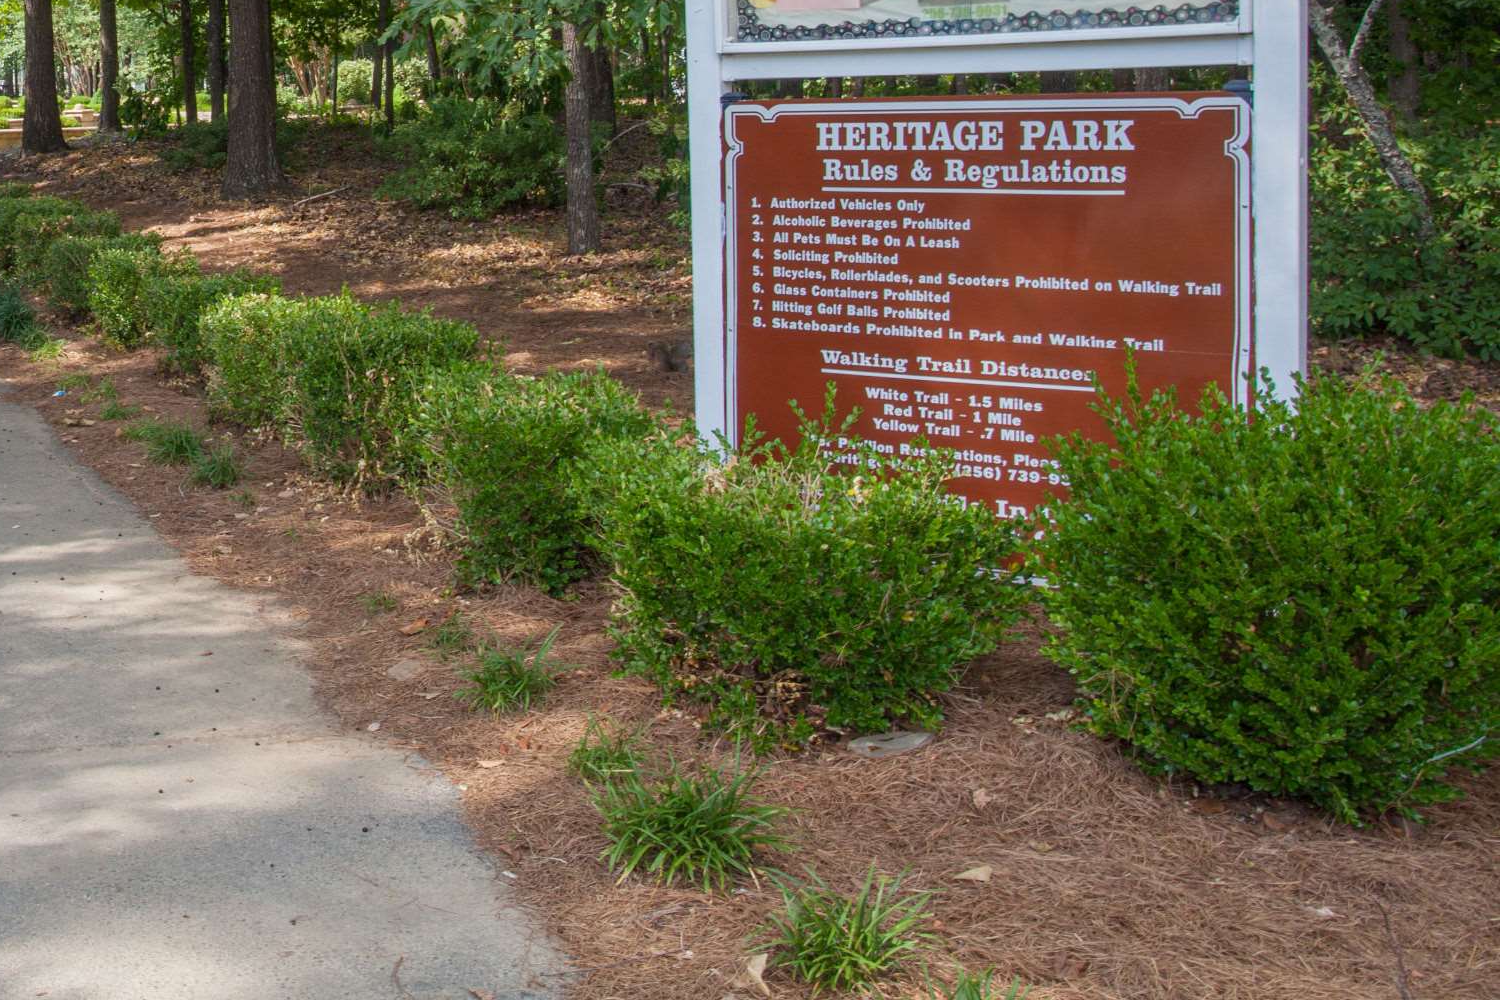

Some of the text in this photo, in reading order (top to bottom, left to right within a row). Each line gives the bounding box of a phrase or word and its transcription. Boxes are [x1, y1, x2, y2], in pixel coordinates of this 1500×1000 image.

[816, 120, 1136, 151] HERITAGE PARK
[823, 159, 1127, 188] Rules & Regulations
[751, 197, 925, 214] 1. Authorized Vehicles Only
[752, 214, 971, 231] 2. Alcoholic Beverages Prohibited
[752, 231, 960, 249] 3. All Pets Must Be On A Leash
[752, 248, 898, 265] 4. Soliciting Prohibited
[752, 265, 1222, 297] 5. Bicycles, Rollerblades, and Scooters Prohibited on Walking Trail
[752, 282, 950, 303] 6. Glass Containers Prohibited
[752, 299, 950, 321] 7. Hitting Golf Balls Prohibited
[752, 316, 1164, 351] 8. Skateboards Prohibited in Park and Walking Trail
[820, 350, 908, 373] Walking
[916, 356, 972, 375] Trail
[865, 387, 908, 402] White
[914, 390, 949, 405] Trail
[968, 395, 993, 408] 1.5
[999, 397, 1043, 412] Miles
[884, 404, 913, 418] Red
[918, 407, 953, 421] Trail
[973, 411, 981, 423] 1
[988, 412, 1022, 426] Mile
[873, 418, 919, 434] Yellow
[925, 422, 960, 437] Trail
[980, 427, 994, 440] .7
[1001, 429, 1035, 443] Mile
[1013, 454, 1061, 470] Pleas
